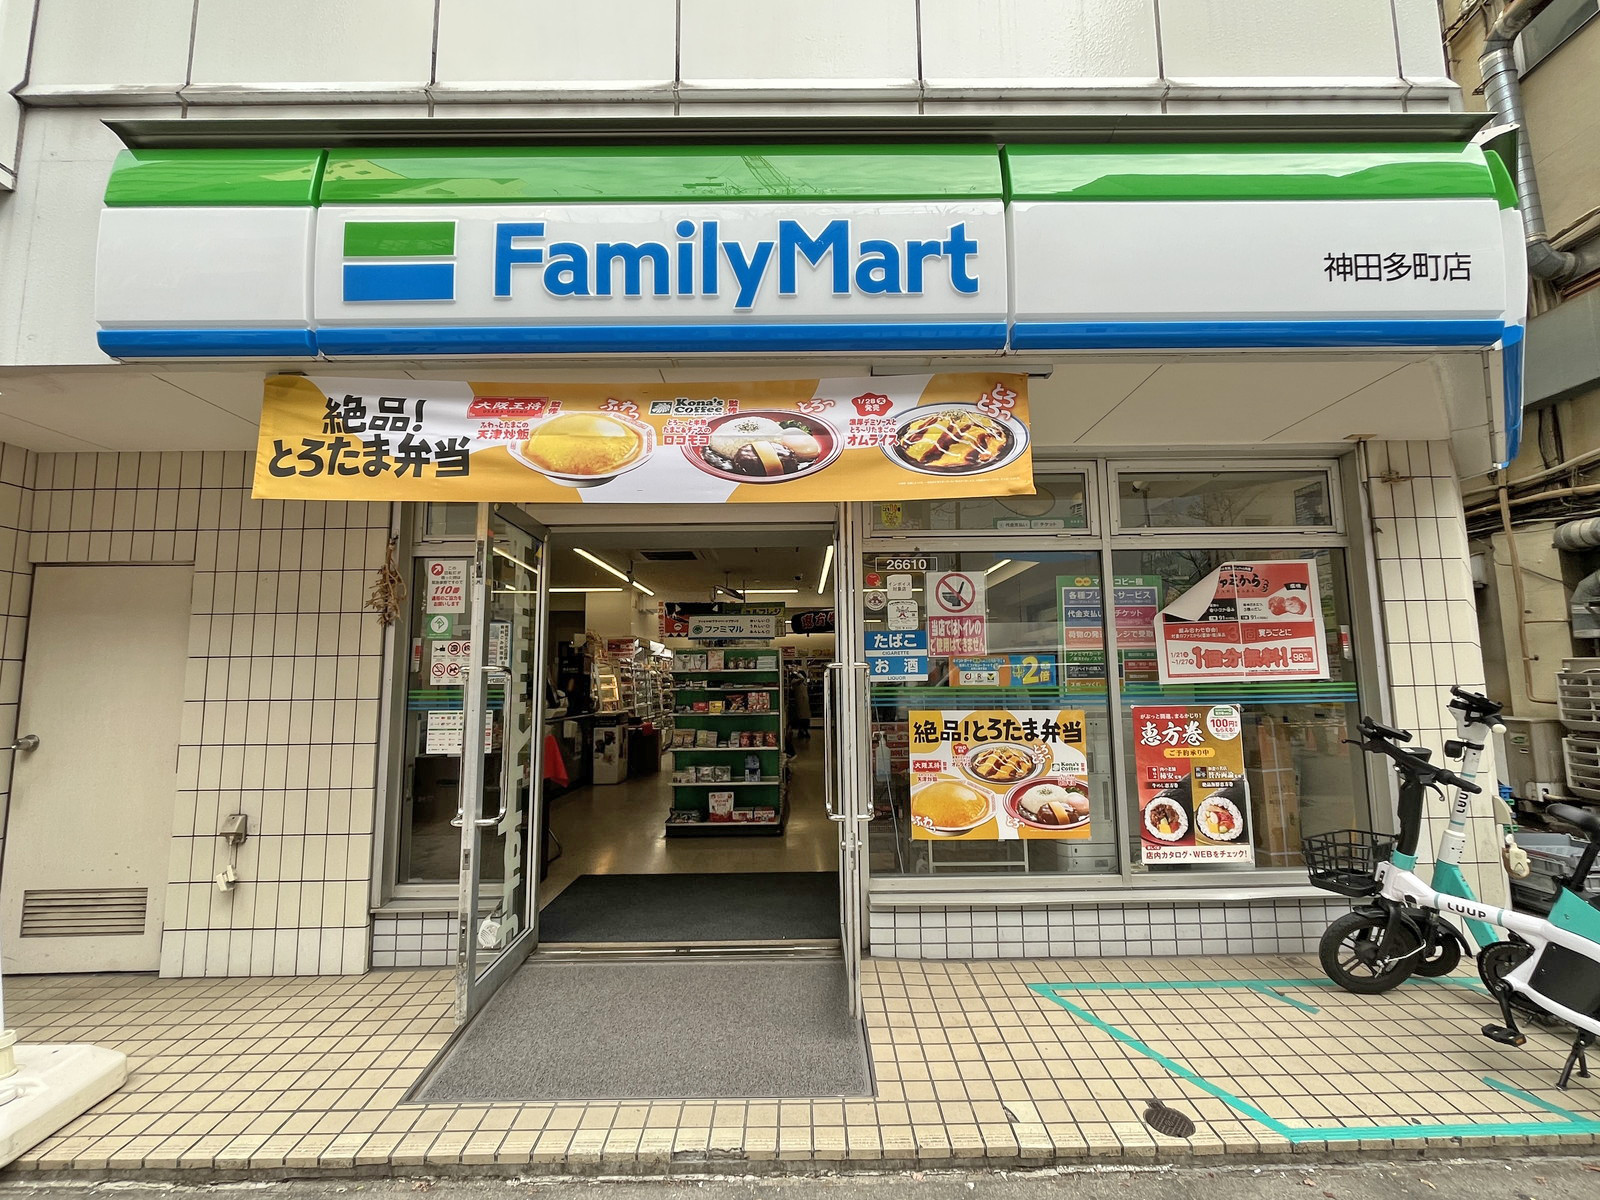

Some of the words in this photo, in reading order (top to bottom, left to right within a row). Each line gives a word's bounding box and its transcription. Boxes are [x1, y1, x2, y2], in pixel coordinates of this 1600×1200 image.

[494, 218, 980, 310] FamilyMart
[1323, 252, 1472, 282] 神田多町店
[474, 401, 542, 411] 大阪王将
[675, 397, 724, 407] Kona's
[864, 404, 880, 412] 発売
[322, 394, 428, 435] 絶品!
[480, 421, 529, 429] ふわっとたまごの
[476, 429, 530, 440] 天津炒飯
[663, 435, 710, 446] ロコモコ
[847, 434, 900, 447] オムライス
[268, 432, 471, 479] とろたま弁当
[886, 559, 927, 570] 26610
[704, 625, 744, 633] ファミマル
[931, 618, 982, 638] 当店ではトイレの
[1258, 628, 1293, 638] 買うごとに
[873, 633, 918, 649] たばこ
[930, 637, 985, 653] ご使用はできません
[913, 717, 1082, 744] 絶品!とろたま弁当
[1139, 720, 1206, 746] 恵方巻
[1168, 749, 1210, 757] ご予約承り中
[1447, 902, 1488, 919] LUUP
